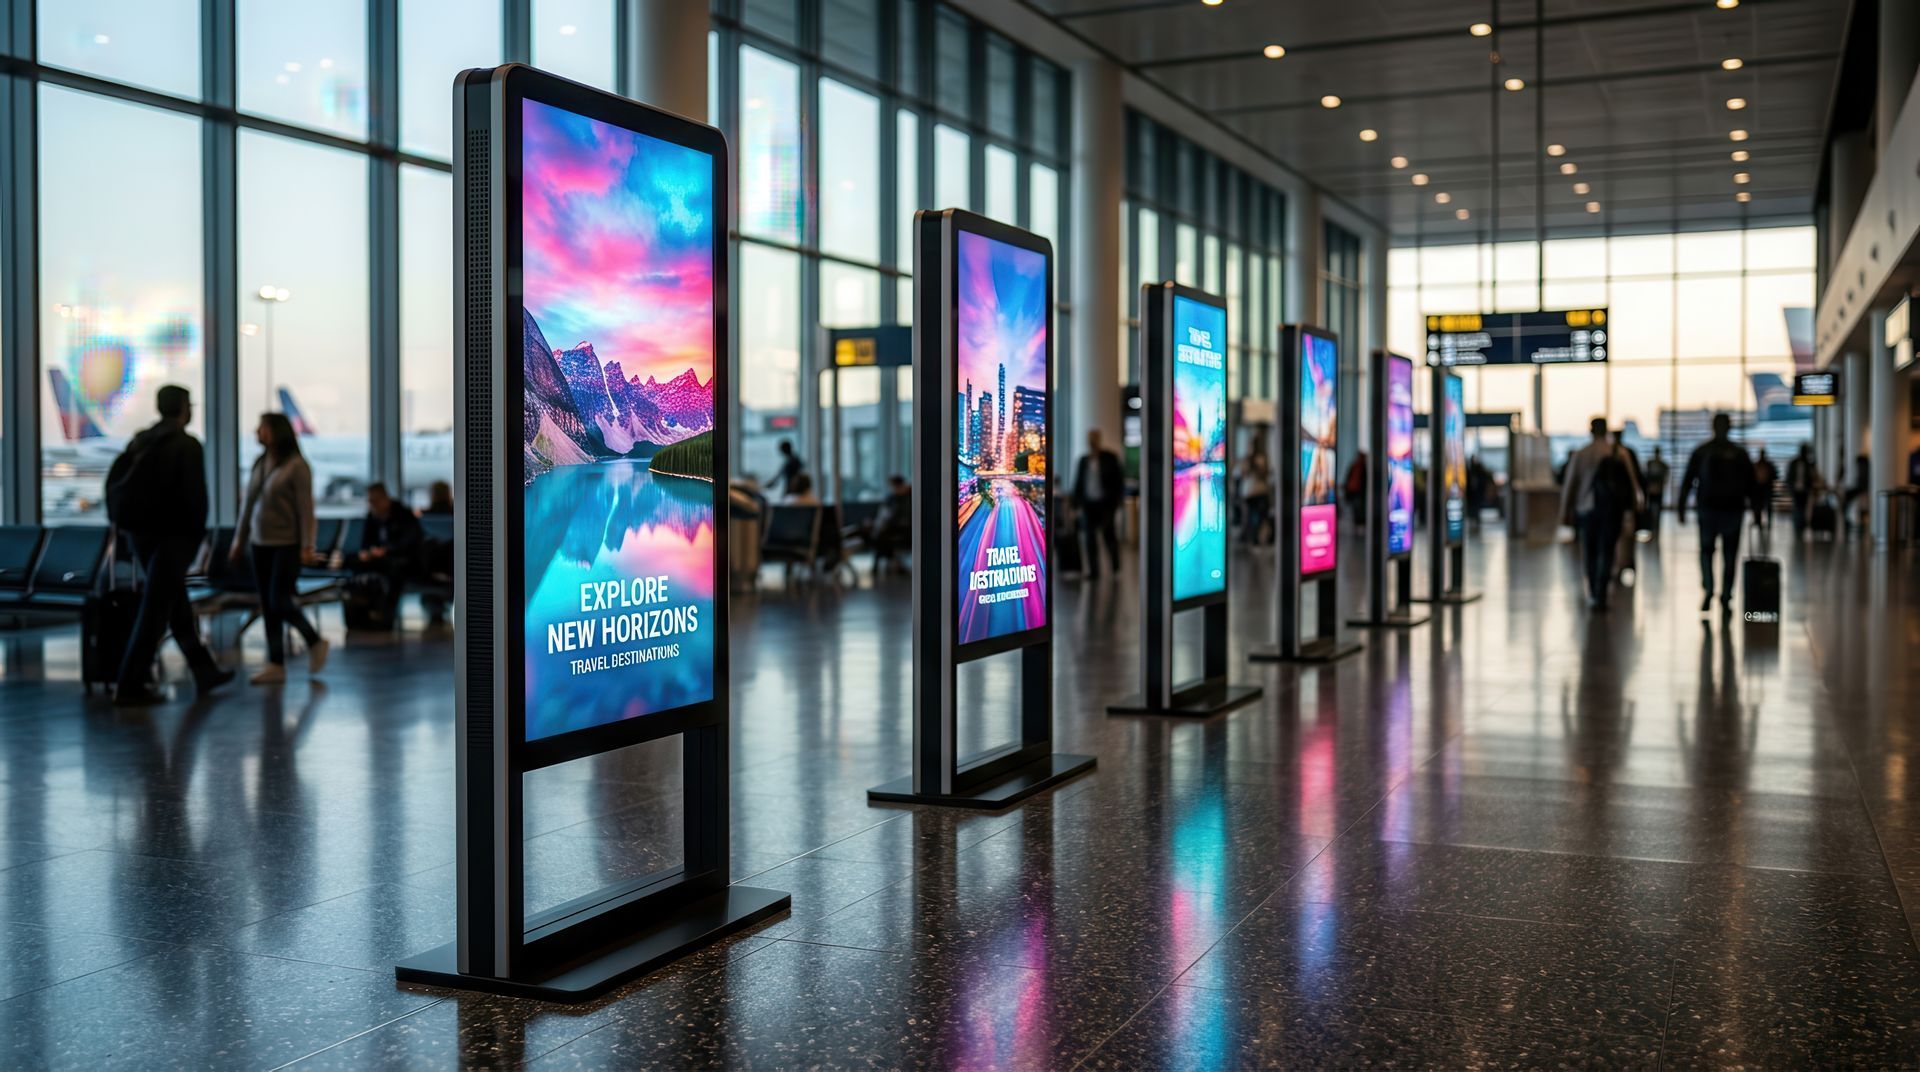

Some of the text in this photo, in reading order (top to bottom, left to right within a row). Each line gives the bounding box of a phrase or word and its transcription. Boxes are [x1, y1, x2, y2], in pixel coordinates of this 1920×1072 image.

[580, 575, 669, 613] EXPLORE
[548, 604, 698, 654] NEW HORIZONS
[570, 656, 610, 675] TRAVEL
